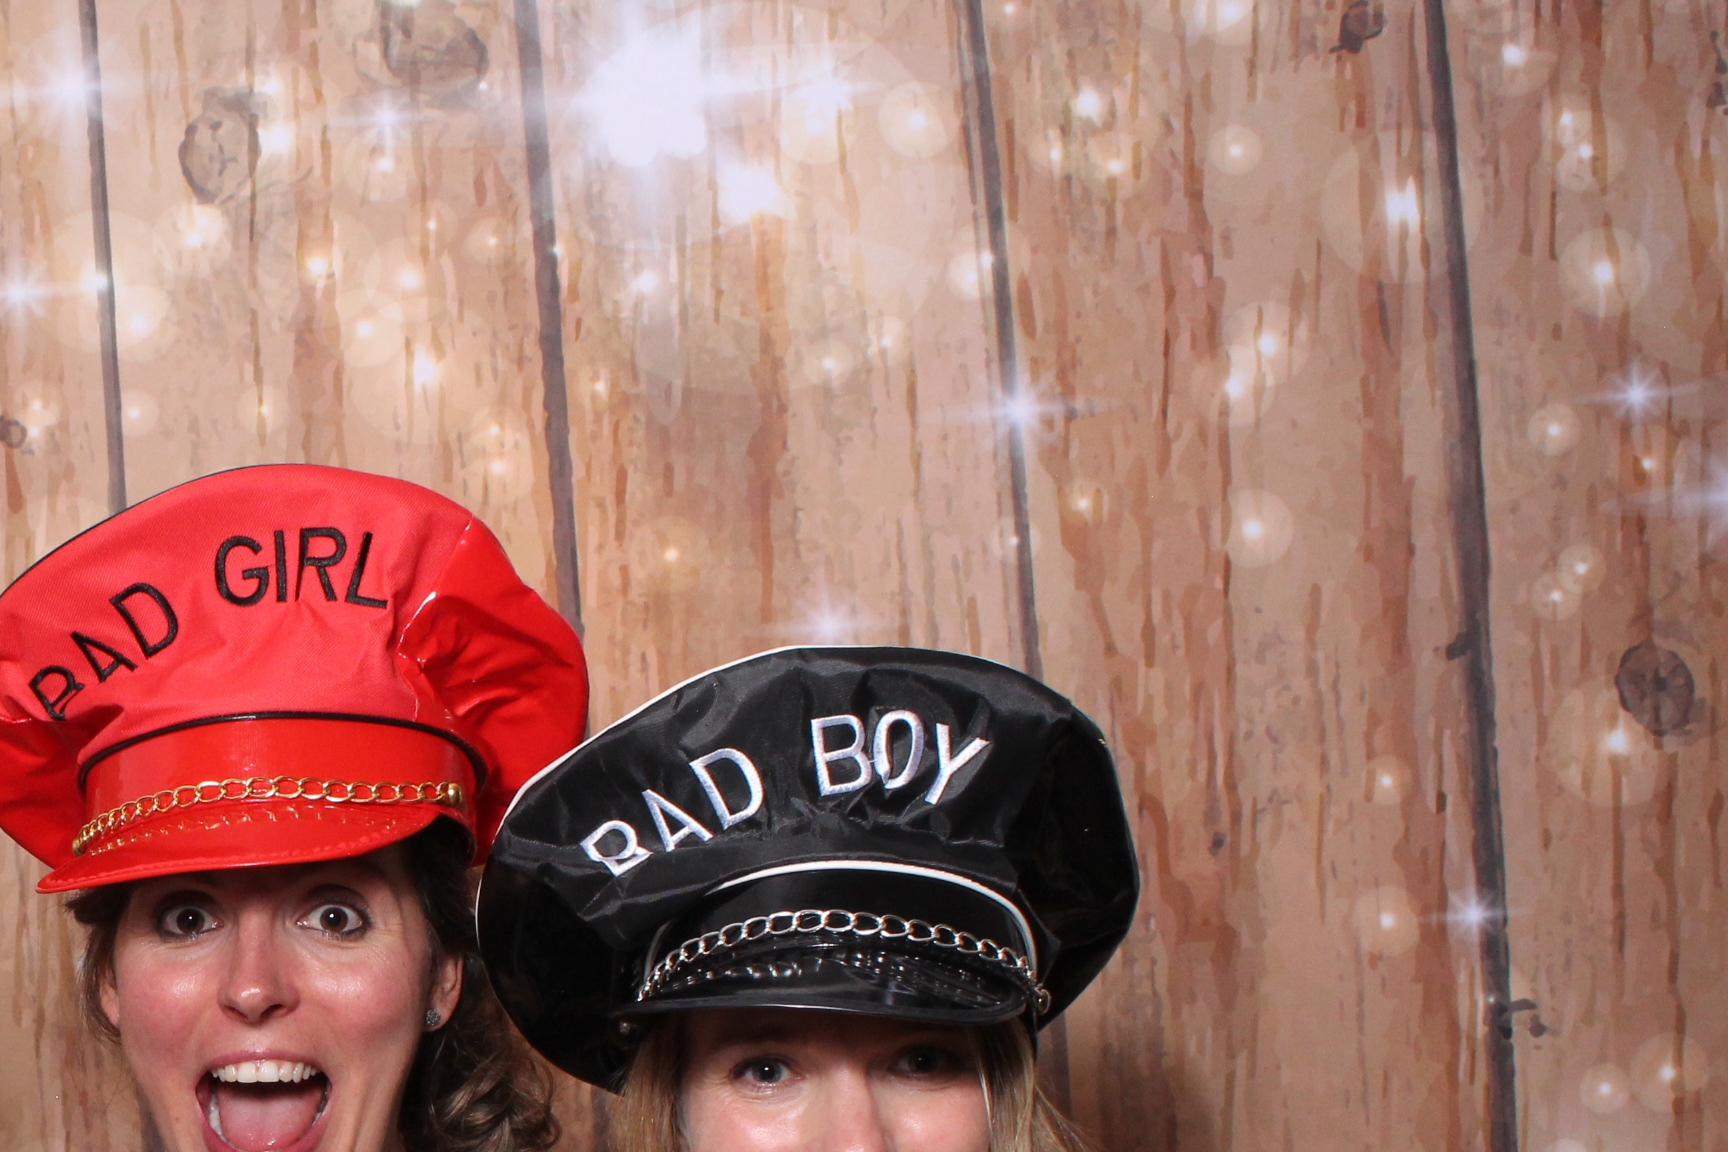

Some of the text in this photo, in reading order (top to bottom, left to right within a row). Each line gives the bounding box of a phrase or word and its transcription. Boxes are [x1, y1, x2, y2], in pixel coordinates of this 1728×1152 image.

[28, 526, 388, 721] BAD GIRL
[579, 709, 990, 877] BAD BOY
